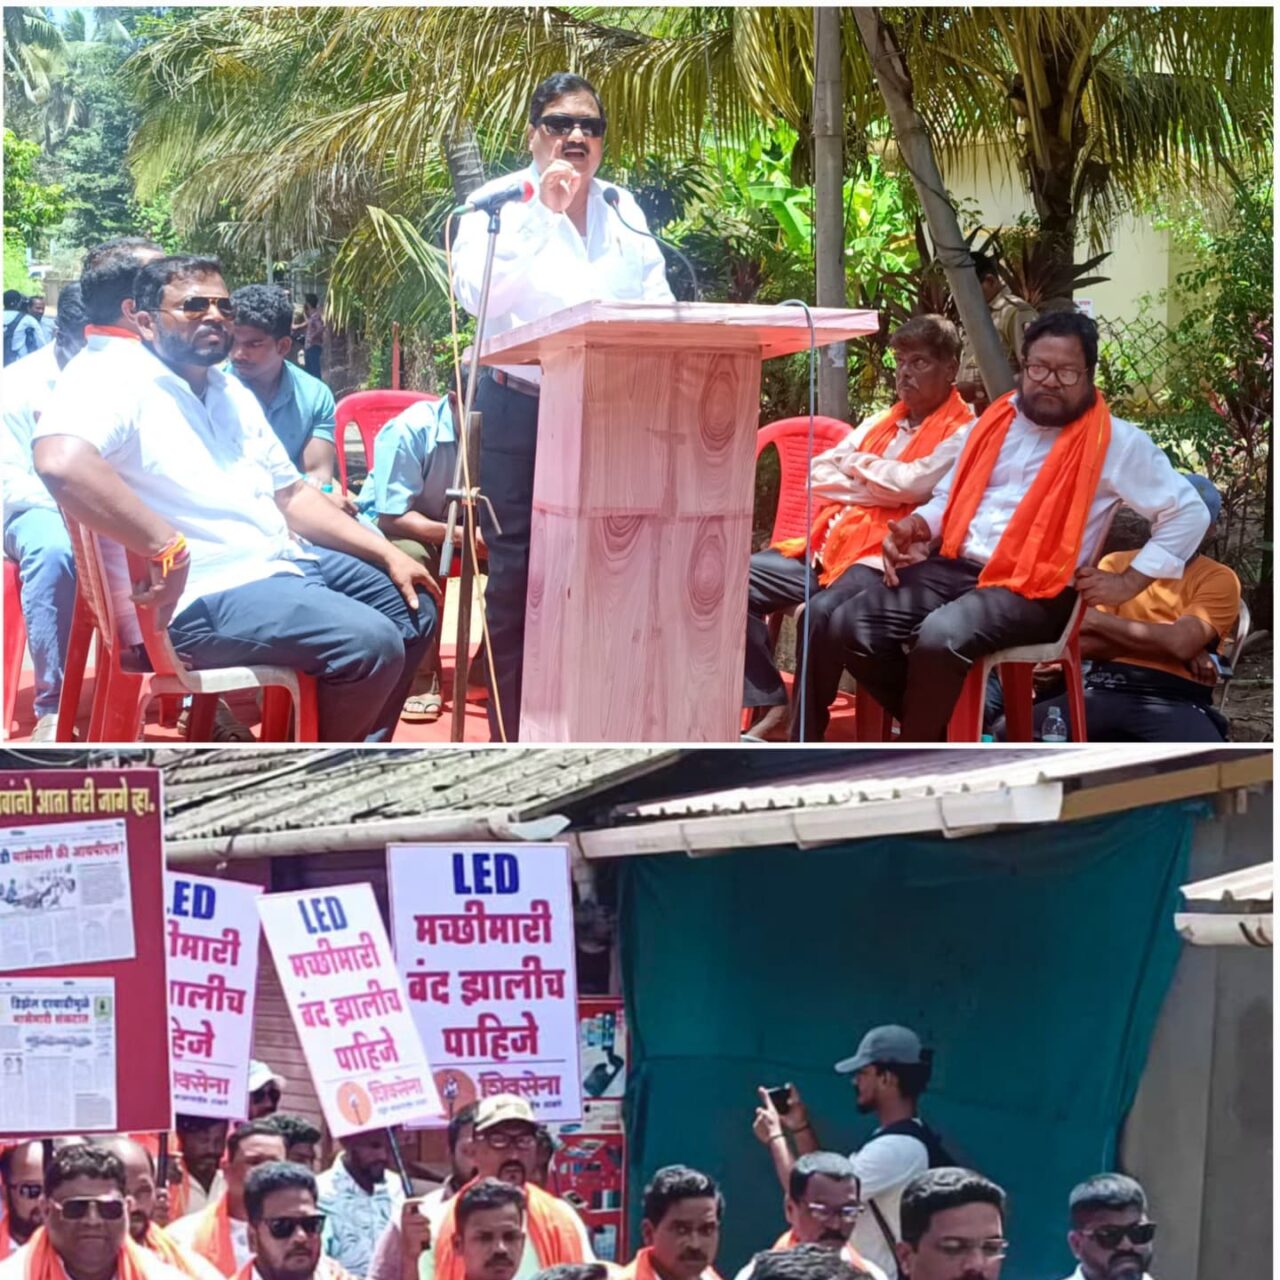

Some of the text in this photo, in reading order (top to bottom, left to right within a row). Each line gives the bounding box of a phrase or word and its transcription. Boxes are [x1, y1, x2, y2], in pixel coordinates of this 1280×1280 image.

[37, 788, 69, 813] आता
[71, 778, 95, 813] तरी
[451, 853, 521, 895] LED
[168, 881, 216, 921] ED
[297, 895, 349, 935] LED
[414, 900, 552, 946] मच्छीमारी
[288, 932, 381, 979] मच्छीमारी
[298, 979, 403, 1028] बंद झालीच
[406, 956, 565, 1006] बंद झालीच
[334, 1026, 400, 1072] पाहिजे
[442, 1011, 538, 1061] पाहिजे
